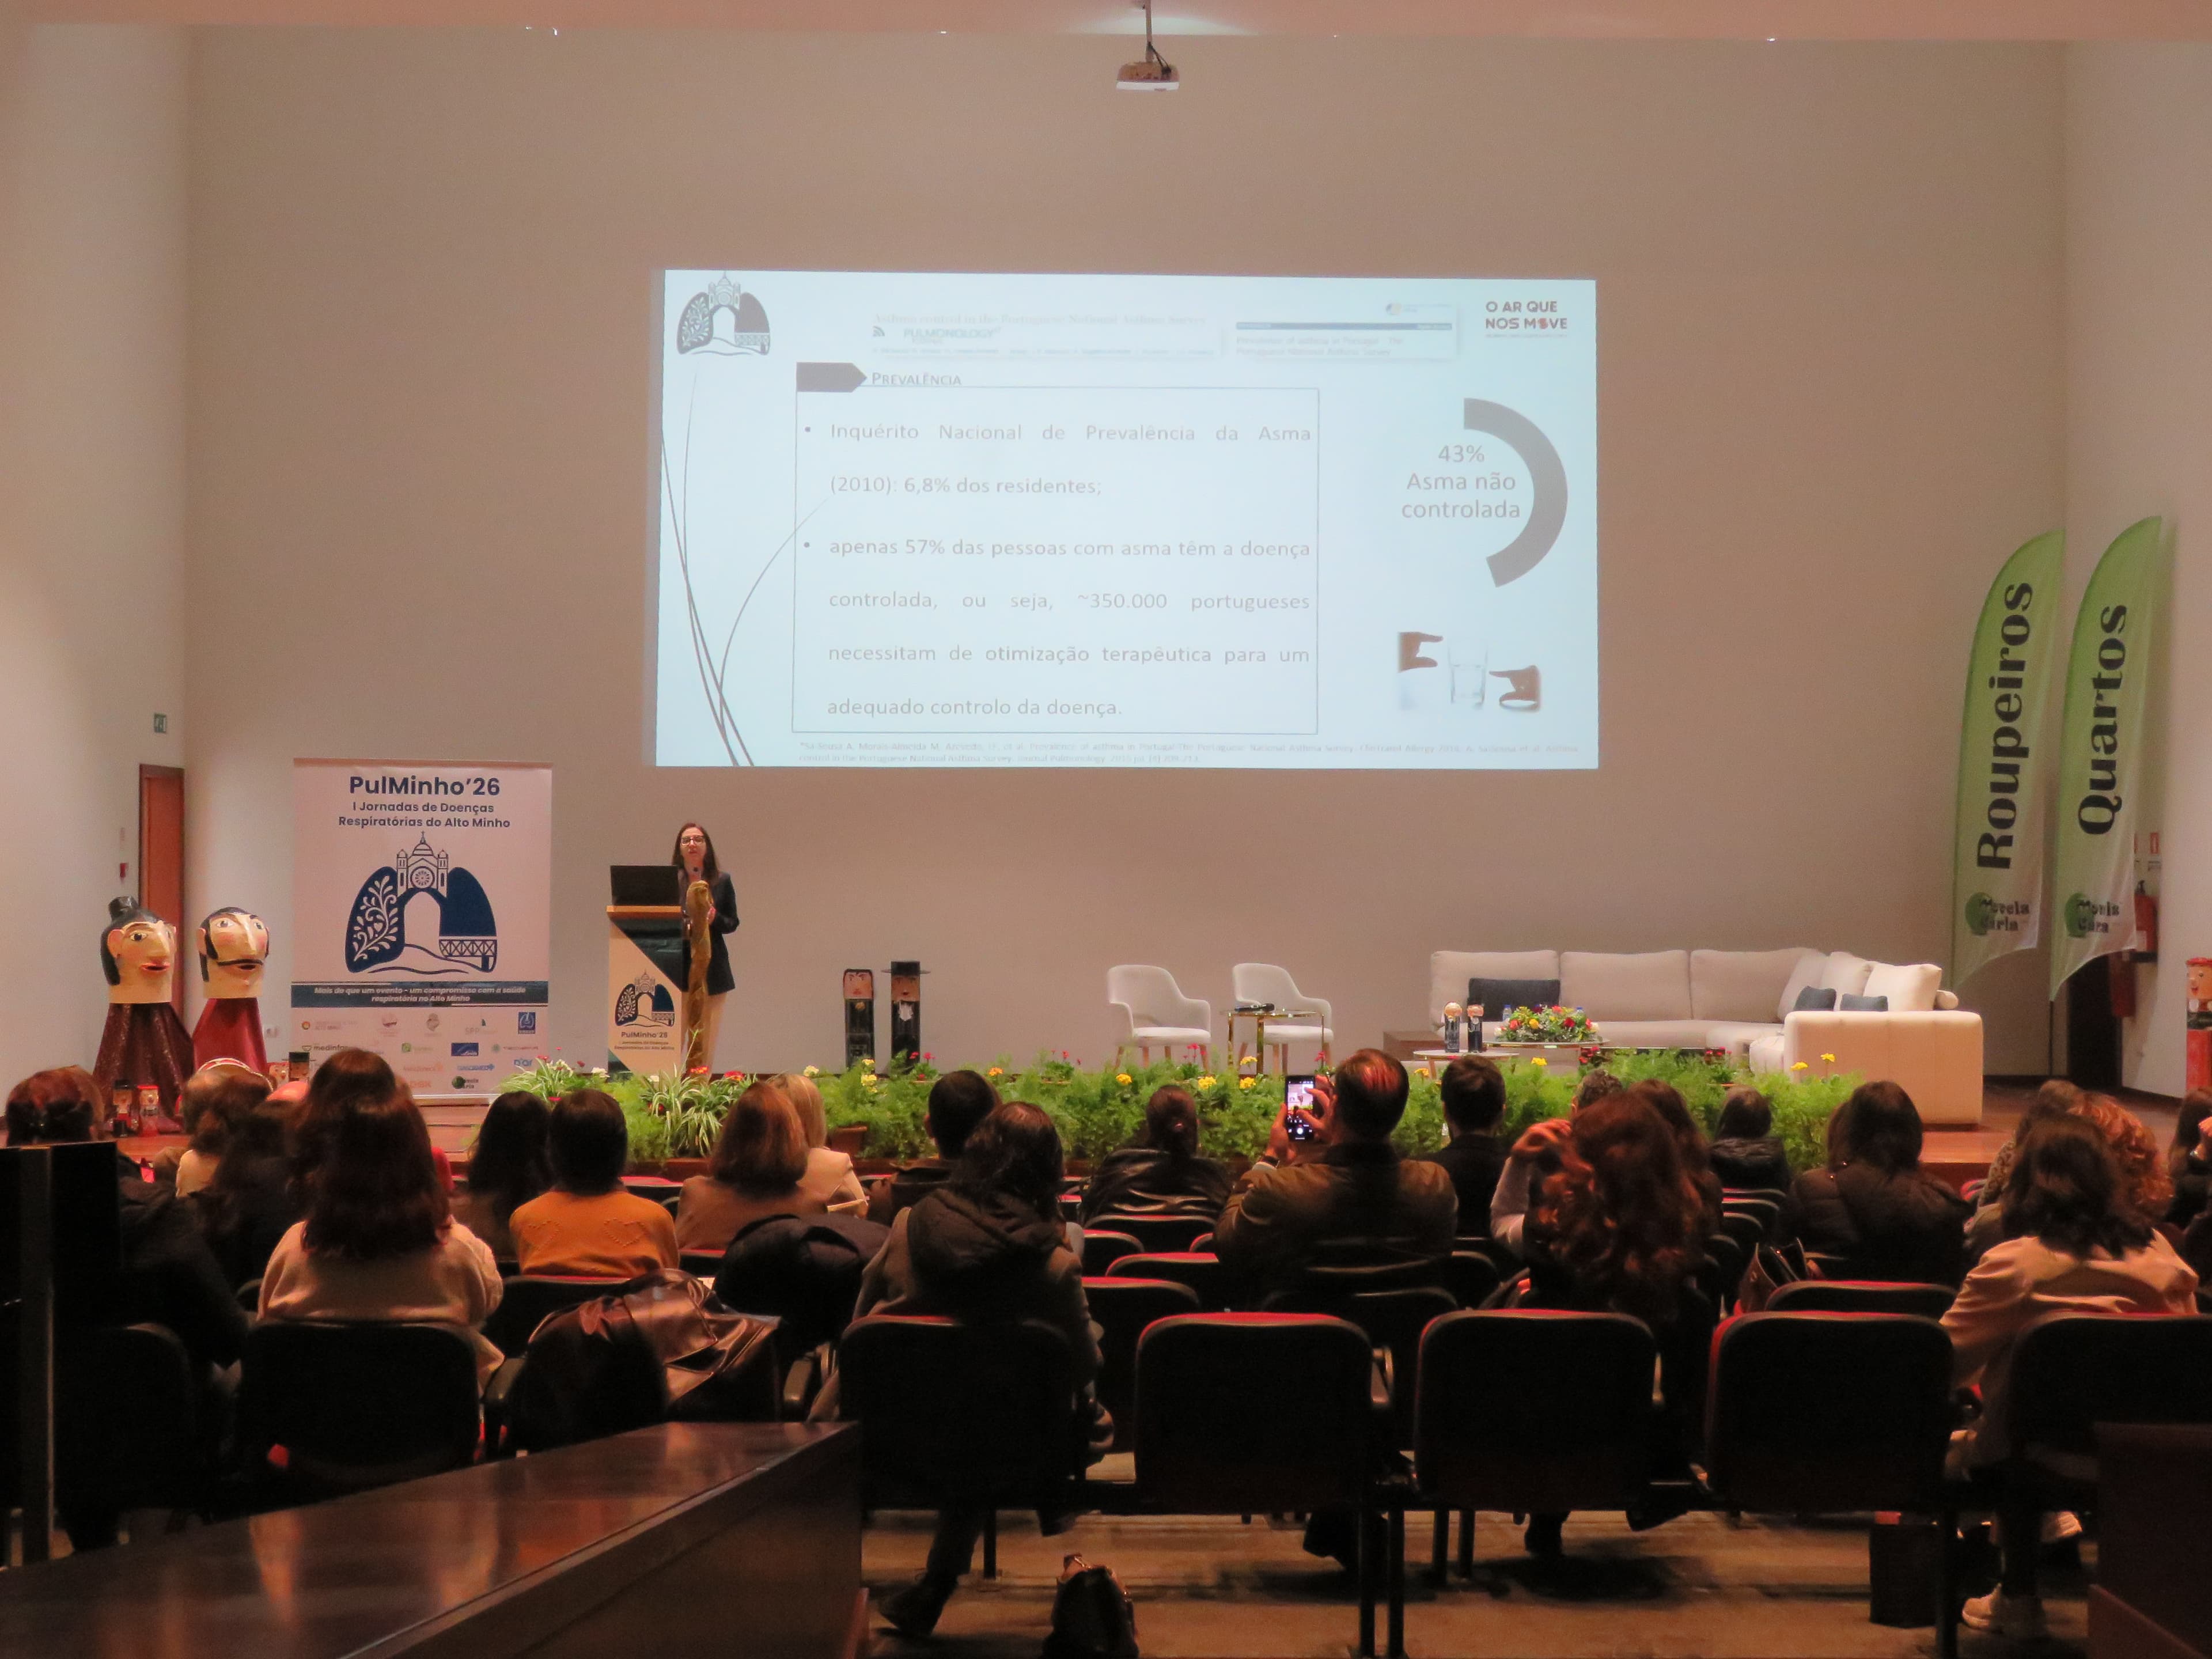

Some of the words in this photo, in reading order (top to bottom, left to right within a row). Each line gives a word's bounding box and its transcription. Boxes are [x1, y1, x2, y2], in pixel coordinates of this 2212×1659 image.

[1485, 301, 1498, 313] O
[1502, 301, 1522, 313] AR
[1527, 301, 1557, 313] QUE
[1485, 317, 1520, 329] NOS
[872, 371, 962, 386] PREVALÊNCIA
[831, 423, 919, 442] Inquérito
[940, 424, 1021, 440] Nacional
[1042, 424, 1065, 440] de
[1086, 425, 1195, 441] Prevalência
[1215, 425, 1238, 441] da
[1258, 426, 1311, 441] Asma
[1438, 444, 1485, 463] 43%
[831, 476, 898, 495] (2010):
[904, 477, 950, 495] 6,8%
[956, 477, 990, 493] dos
[997, 477, 1101, 495] residentes;
[1407, 472, 1467, 490] Asma
[1475, 472, 1516, 490] não
[1402, 499, 1520, 518] controlada
[830, 542, 897, 558] apenas
[906, 539, 945, 554] 57%
[952, 539, 984, 555] das
[991, 544, 1067, 559] pessoas
[1074, 544, 1113, 555] com
[1121, 544, 1171, 556] asma
[1179, 540, 1215, 556] têm
[1223, 544, 1233, 556] a
[1240, 540, 1310, 560] doença
[829, 590, 937, 609] controlada,
[962, 596, 986, 608] ou
[1010, 593, 1053, 611] seja,
[1078, 593, 1167, 609] ~350.000
[1191, 594, 1309, 613] portugueses
[829, 646, 935, 661] necessitam
[949, 644, 972, 661] de
[986, 646, 1089, 665] otimização
[1102, 646, 1211, 665] terapêutica
[1225, 650, 1266, 665] para
[1279, 651, 1309, 662] um
[827, 698, 925, 718] adequado
[930, 698, 1011, 715] controlo
[1017, 698, 1040, 714] da
[1047, 699, 1122, 718] doença.
[1976, 582, 2033, 869] Roupeiros
[2077, 605, 2127, 835] Quartos
[350, 775, 500, 796] PulMinho'26
[359, 801, 419, 812] Jornadas
[422, 802, 438, 812] de
[440, 802, 494, 816] Doenças
[339, 816, 423, 829] Respiratórias
[426, 817, 442, 827] do
[444, 817, 469, 827] Alto
[472, 817, 510, 828] Minho
[372, 995, 418, 1003] respiratória
[423, 987, 476, 995] compromisso
